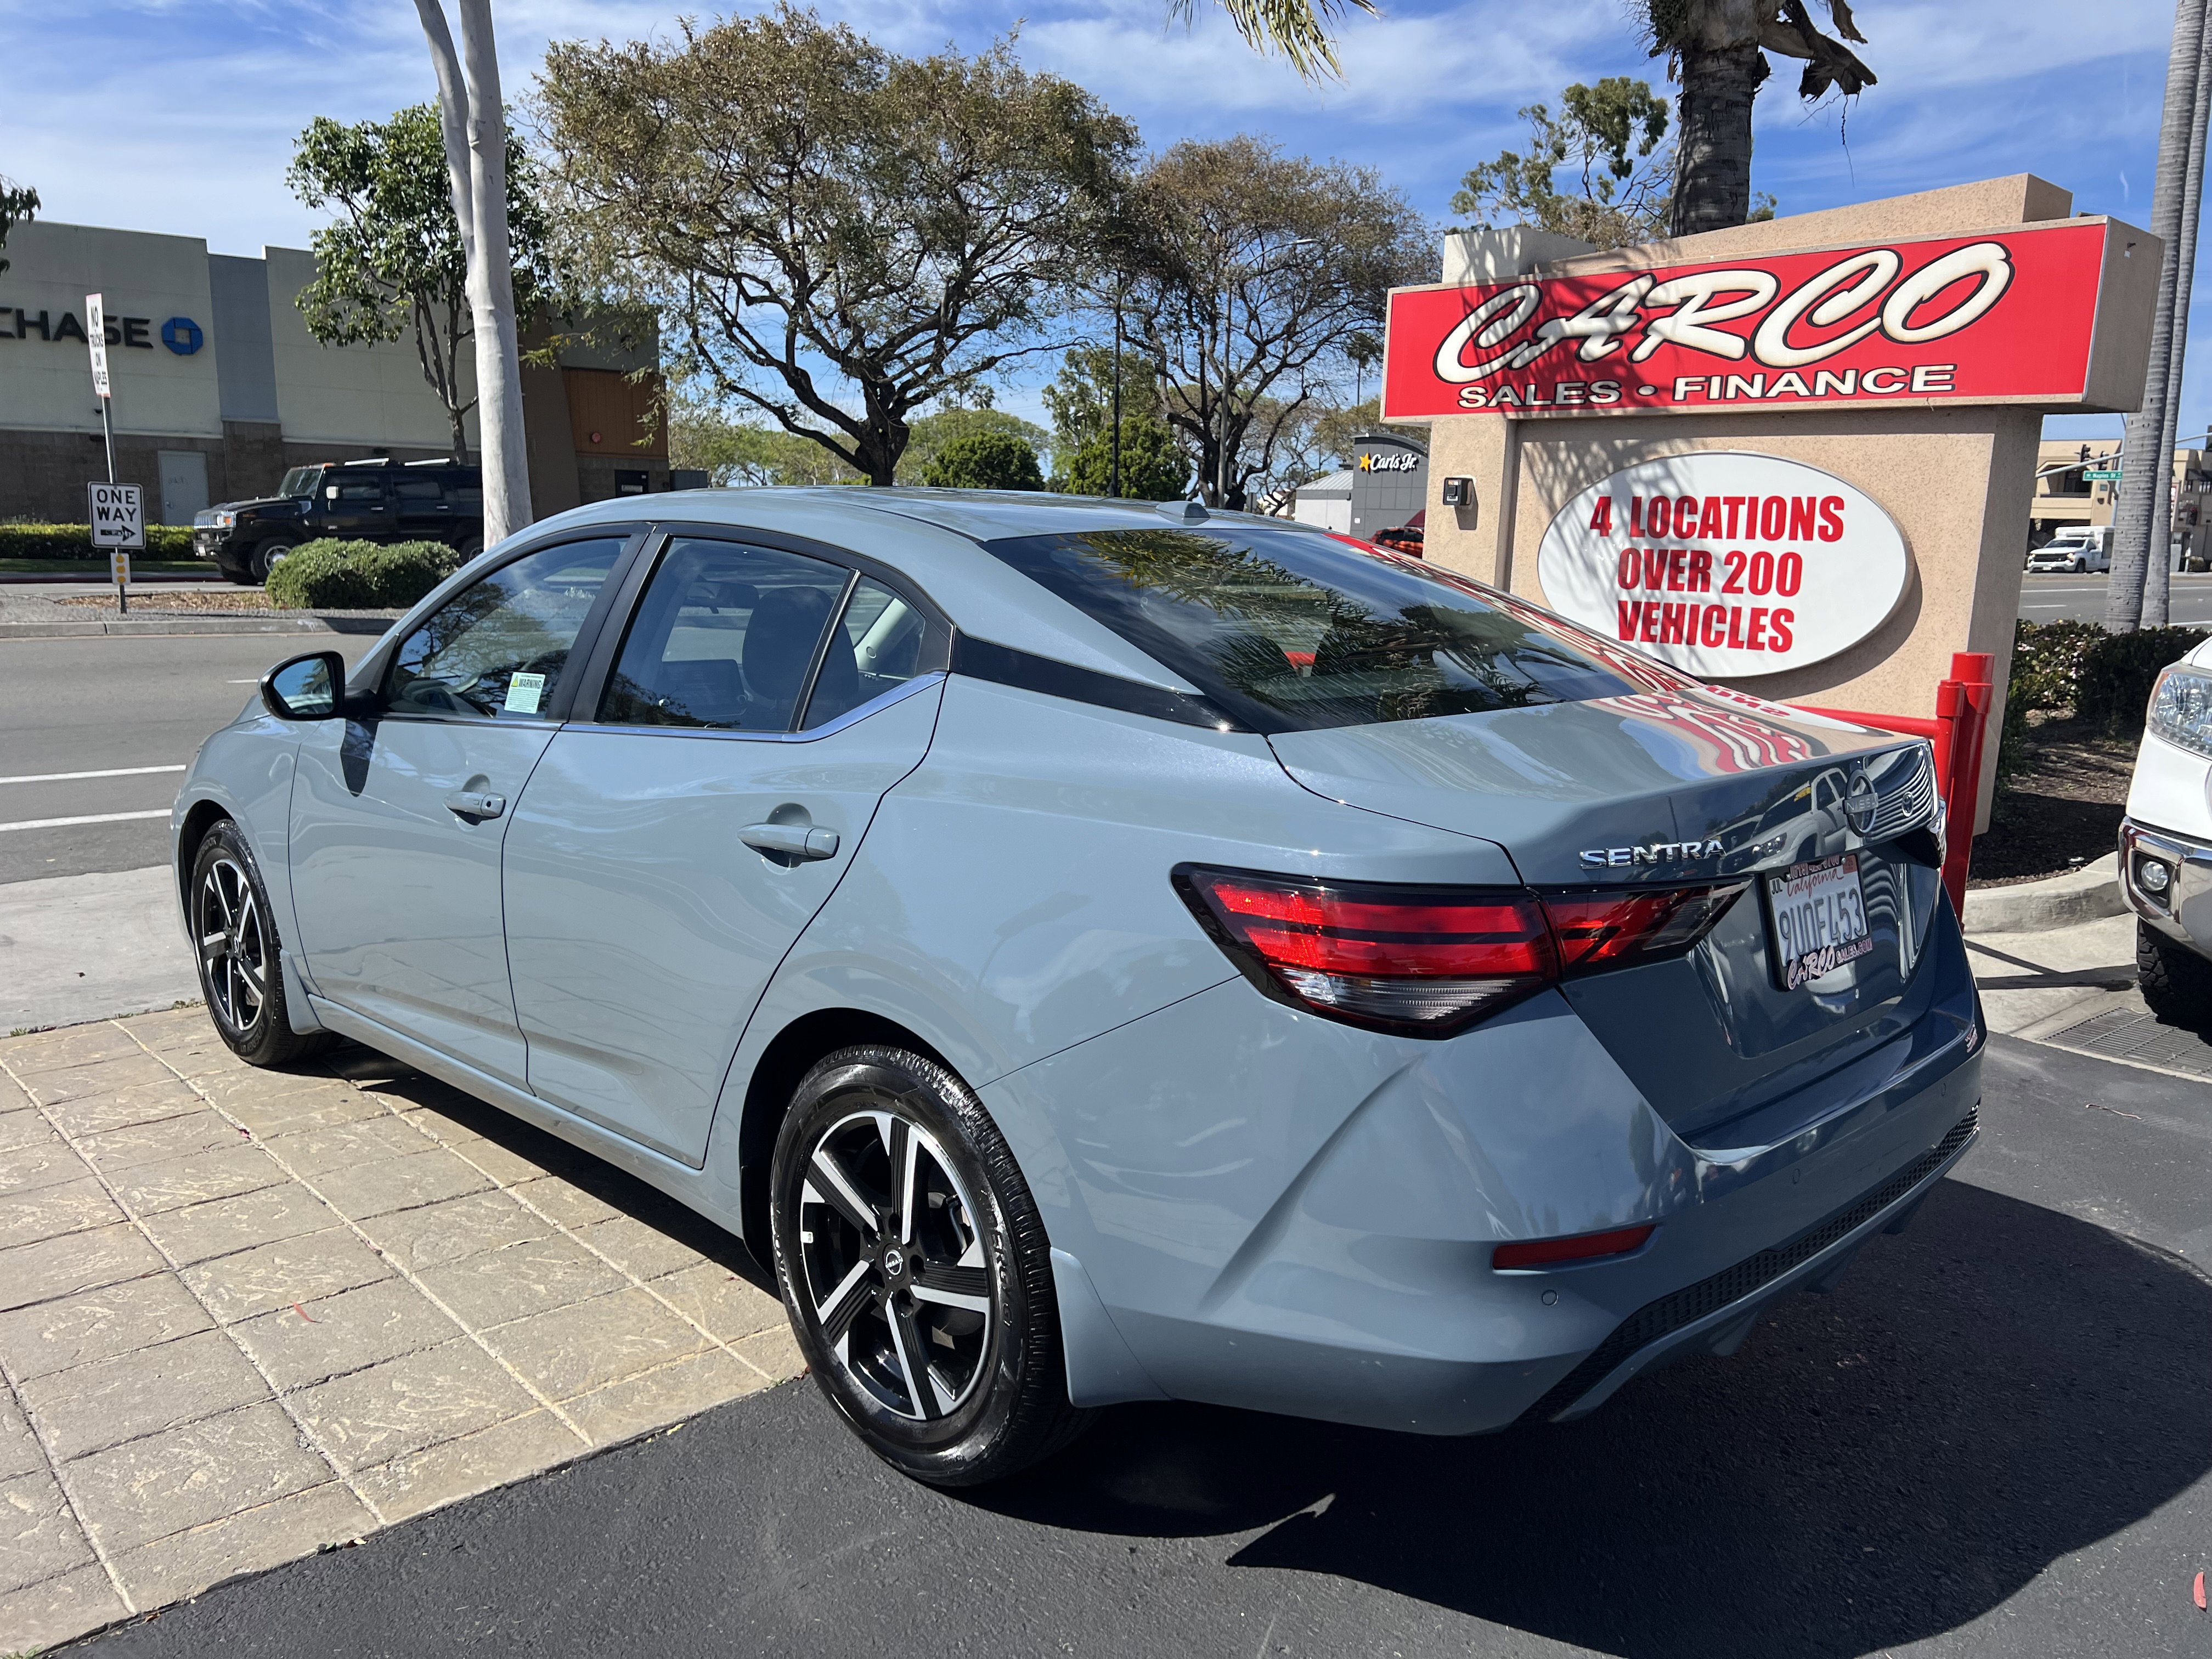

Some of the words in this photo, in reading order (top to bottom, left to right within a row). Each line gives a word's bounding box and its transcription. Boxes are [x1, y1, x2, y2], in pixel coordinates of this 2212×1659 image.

[90, 306, 99, 328] NO
[1434, 241, 2012, 383] CARCO
[1458, 380, 1623, 409] SALES
[1672, 363, 1957, 401] FINANCE
[1370, 453, 1400, 470] Carl's
[1400, 453, 1417, 470] Jr.
[97, 488, 136, 504] ONE
[97, 506, 137, 522] WAY
[1590, 495, 1612, 537] 4
[1629, 495, 1844, 543] LOCATIONS
[1617, 547, 1713, 592] OVER
[1722, 550, 1803, 597] 200
[1617, 600, 1795, 653] VEHICLES
[1579, 839, 1728, 870] SENTRA
[1771, 878, 1783, 895] JUL
[1787, 868, 1845, 899] California
[1787, 945, 1835, 990] CARCO
